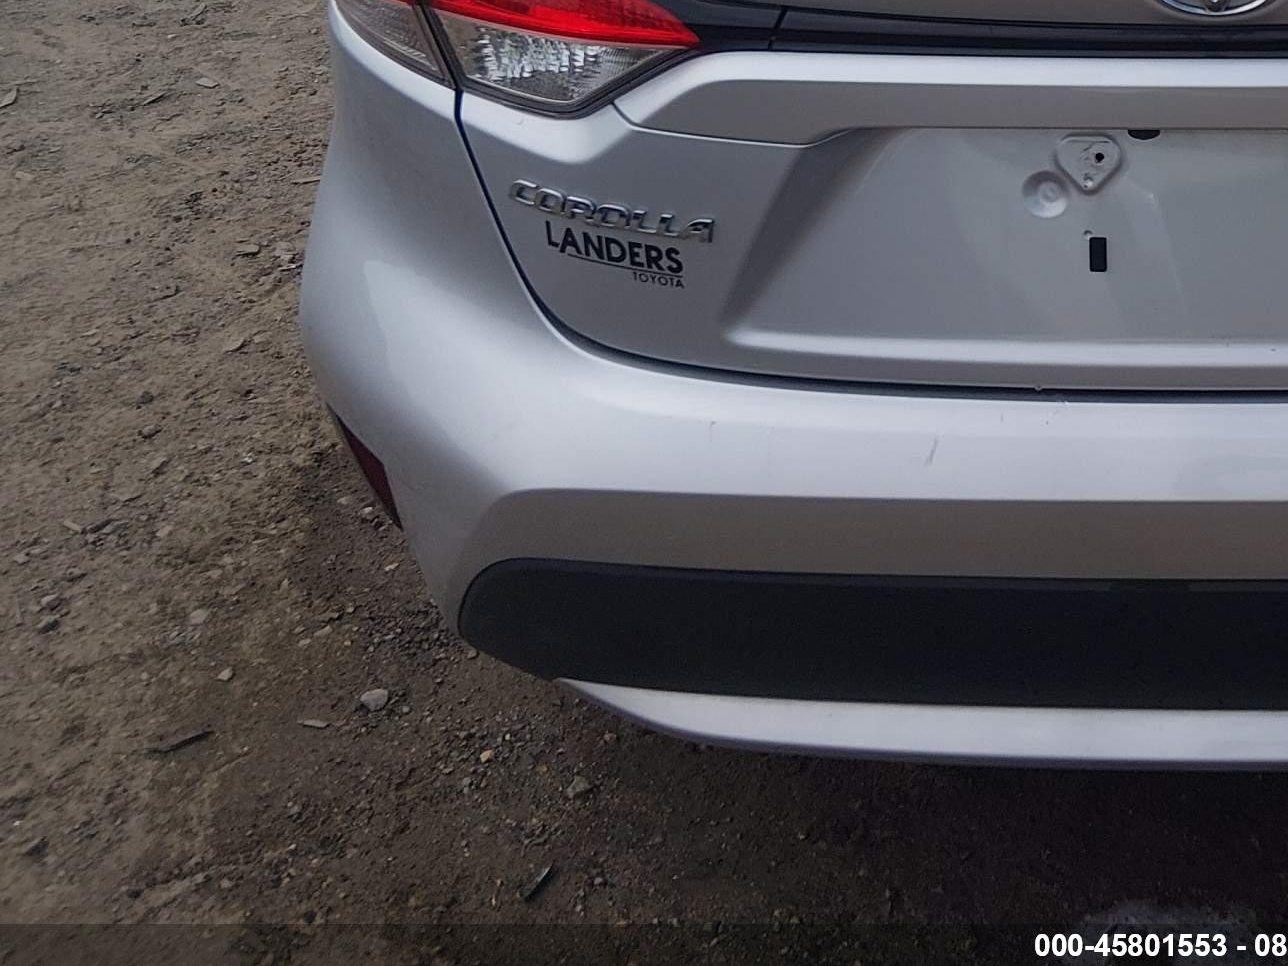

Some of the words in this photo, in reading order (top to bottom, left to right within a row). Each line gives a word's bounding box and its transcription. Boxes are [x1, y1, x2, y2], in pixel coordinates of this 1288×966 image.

[510, 179, 715, 242] COROLLA
[545, 220, 683, 273] LANDERS
[633, 271, 684, 288] TOYOTA
